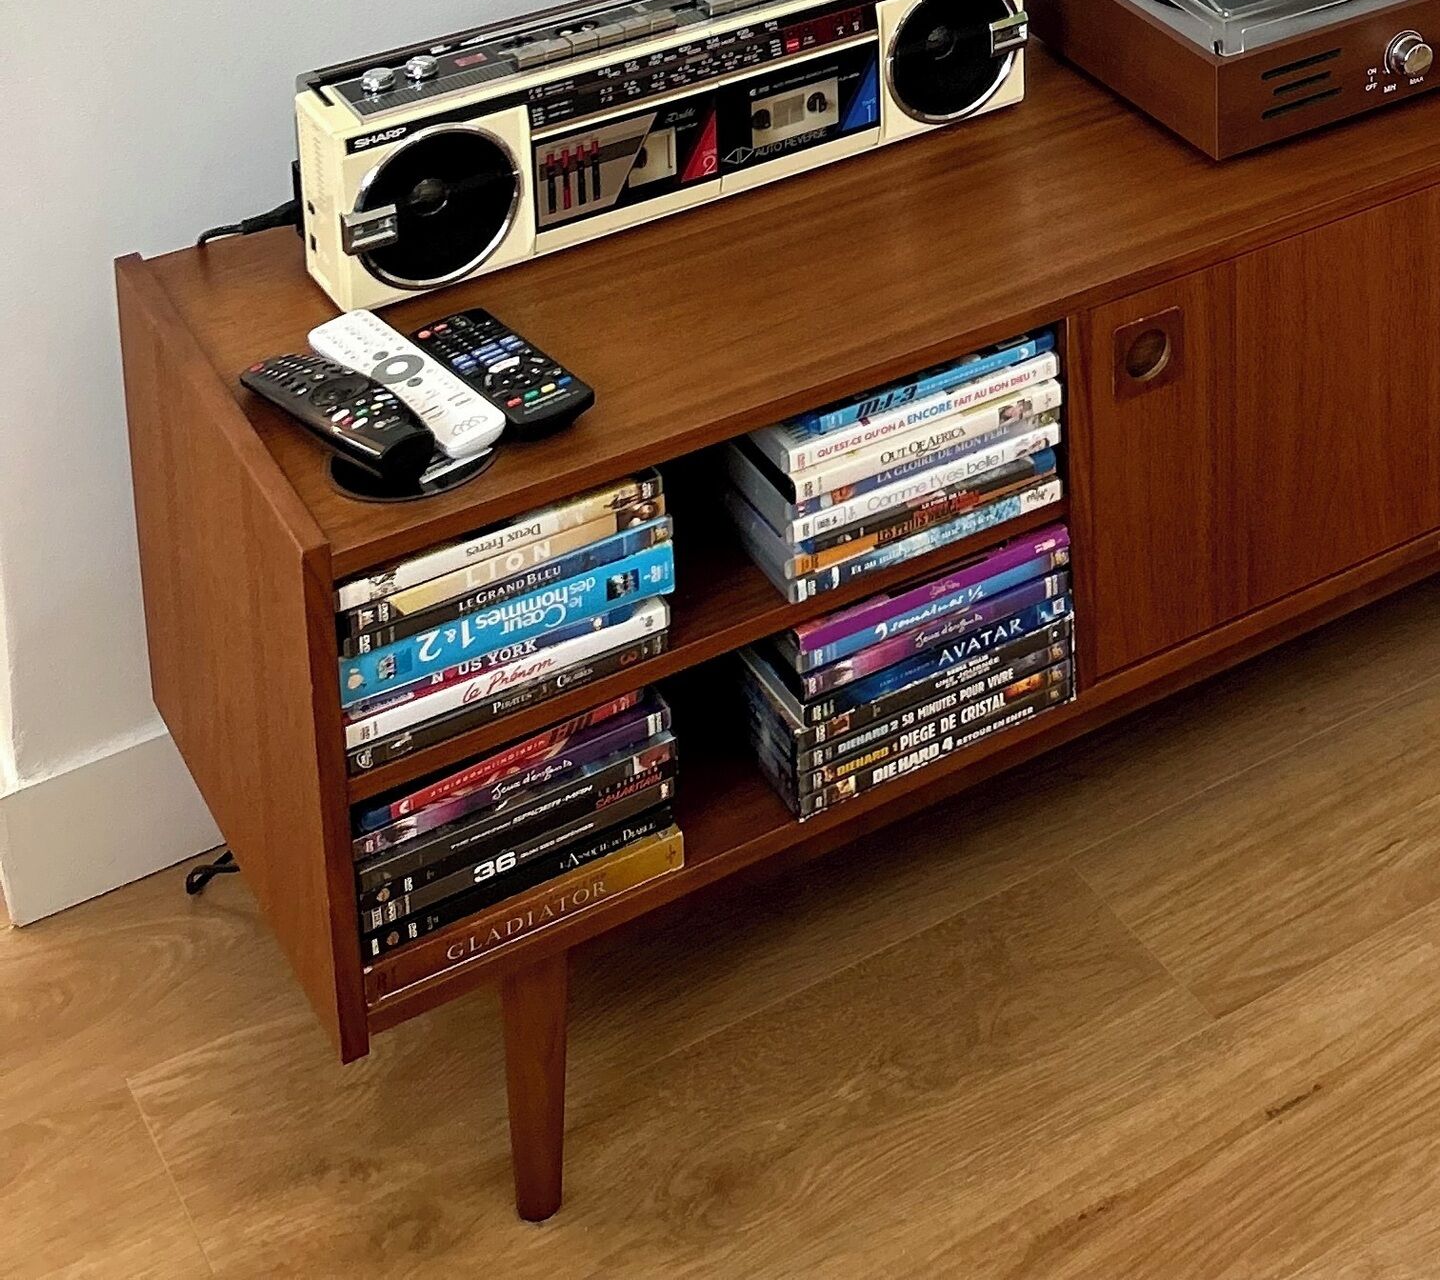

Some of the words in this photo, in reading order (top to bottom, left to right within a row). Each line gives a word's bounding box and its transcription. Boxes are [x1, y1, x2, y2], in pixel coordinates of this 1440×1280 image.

[1365, 82, 1378, 92] OFF
[353, 127, 407, 150] SHARP
[754, 142, 784, 158] AUTO
[785, 128, 828, 149] REVERSE
[702, 155, 716, 177] 2
[817, 435, 862, 459] QU'EST-CE
[863, 422, 896, 441] QU'ON
[897, 419, 906, 430] A
[907, 399, 953, 426] ENCORE
[953, 394, 972, 408] FAIT
[973, 389, 988, 401] AU
[988, 381, 1010, 395] BON
[1010, 373, 1031, 388] DIEU
[876, 471, 893, 484] LA
[892, 453, 937, 477] GLOIRE
[936, 446, 954, 460] DE
[954, 435, 981, 452] MON
[879, 449, 909, 466] OUT
[926, 426, 967, 451] AFRICA
[866, 480, 927, 513] Comme
[507, 523, 542, 540] Deux
[465, 540, 551, 589] LION
[458, 597, 475, 613] LE
[474, 578, 526, 605] GRAND
[525, 565, 562, 586] BLEU
[568, 576, 597, 594] des
[475, 586, 569, 630] hommes
[568, 595, 583, 609] le
[443, 628, 458, 644] &
[460, 617, 477, 650] 1
[499, 603, 568, 637] Cœur
[874, 622, 888, 642] 9
[415, 628, 443, 663] 2
[485, 638, 539, 667] YORK
[914, 628, 941, 649] Jeux
[938, 617, 1025, 667] AVATAR
[488, 657, 558, 695] Prénom
[491, 692, 533, 715] PIRATES
[888, 721, 900, 734] 2
[901, 714, 915, 729] 58
[916, 695, 958, 724] MINUTES
[958, 680, 986, 704] POUR
[986, 667, 1015, 691] VIVRE
[899, 721, 937, 753] PIEGE
[939, 712, 958, 735] DE
[960, 692, 1008, 725] CRISTAL
[939, 735, 955, 753] 4
[490, 781, 522, 802] Jeux
[511, 784, 594, 826] SPIDER-MAN
[473, 850, 517, 885] 36
[445, 880, 608, 962] GLADIATOR
